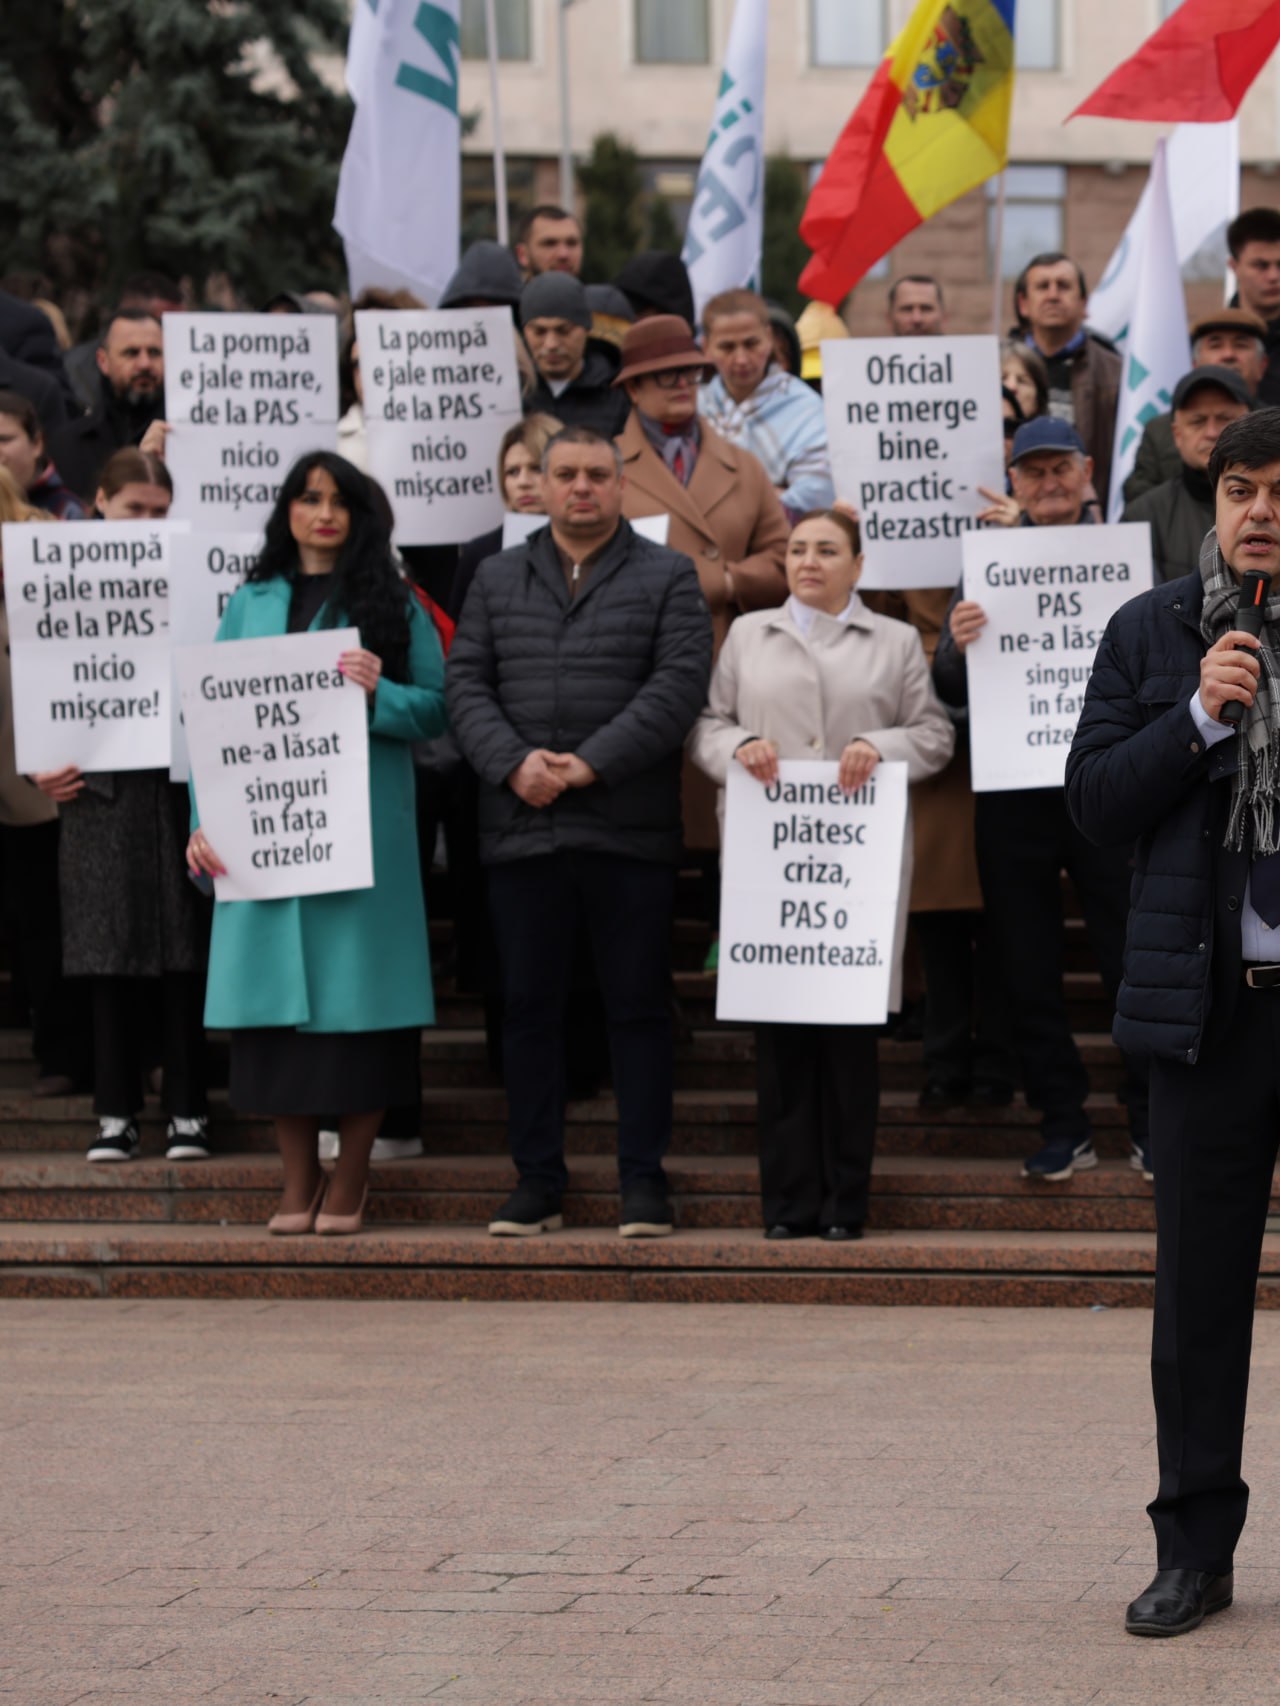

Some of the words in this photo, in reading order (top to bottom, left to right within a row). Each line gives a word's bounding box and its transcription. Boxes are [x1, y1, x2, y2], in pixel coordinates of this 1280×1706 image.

[190, 326, 216, 353] La
[222, 327, 311, 361] pompă
[379, 324, 401, 350] La
[406, 321, 488, 355] pompă
[180, 369, 193, 389] e
[198, 362, 243, 395] jale
[250, 369, 322, 395] mare,
[373, 365, 385, 387] e
[388, 359, 426, 392] jale
[432, 363, 503, 386] mare,
[866, 353, 952, 386] Oficial
[190, 399, 220, 425] de
[225, 399, 247, 425] la
[254, 399, 299, 425] PAS
[383, 394, 407, 421] de
[412, 394, 432, 421] la
[438, 392, 483, 420] PAS
[847, 401, 880, 424] ne
[887, 398, 978, 430] merge
[221, 440, 279, 468] nicio
[411, 435, 468, 462] nicio
[200, 476, 283, 511] mișcar
[394, 468, 494, 505] mișcare!
[860, 471, 953, 511] practic
[32, 537, 62, 565] La
[69, 533, 163, 569] pompă
[985, 561, 1131, 588] Guvernarea
[22, 582, 37, 604] e
[43, 574, 92, 609] jale
[1037, 591, 1083, 618] PAS
[36, 611, 69, 640] de
[75, 610, 100, 638] la
[106, 609, 154, 637] PAS
[1000, 630, 1055, 653] ne-a
[1062, 624, 1105, 650] lăs
[73, 653, 136, 683] nicio
[200, 666, 346, 701] Guvernarea
[1026, 662, 1093, 689] singur
[50, 689, 160, 728] mișcare!
[255, 700, 301, 729] PAS
[221, 741, 277, 766] ne-a
[282, 731, 342, 760] lăsat
[1027, 723, 1074, 746] crize
[245, 770, 328, 807] singuri
[250, 811, 275, 836] în
[282, 803, 328, 839] fața
[772, 814, 867, 850] plătesc
[251, 838, 334, 870] crizelor
[783, 855, 853, 889] criza,
[780, 900, 828, 929] PAS
[833, 908, 849, 930] o
[729, 938, 884, 967] comentează.
